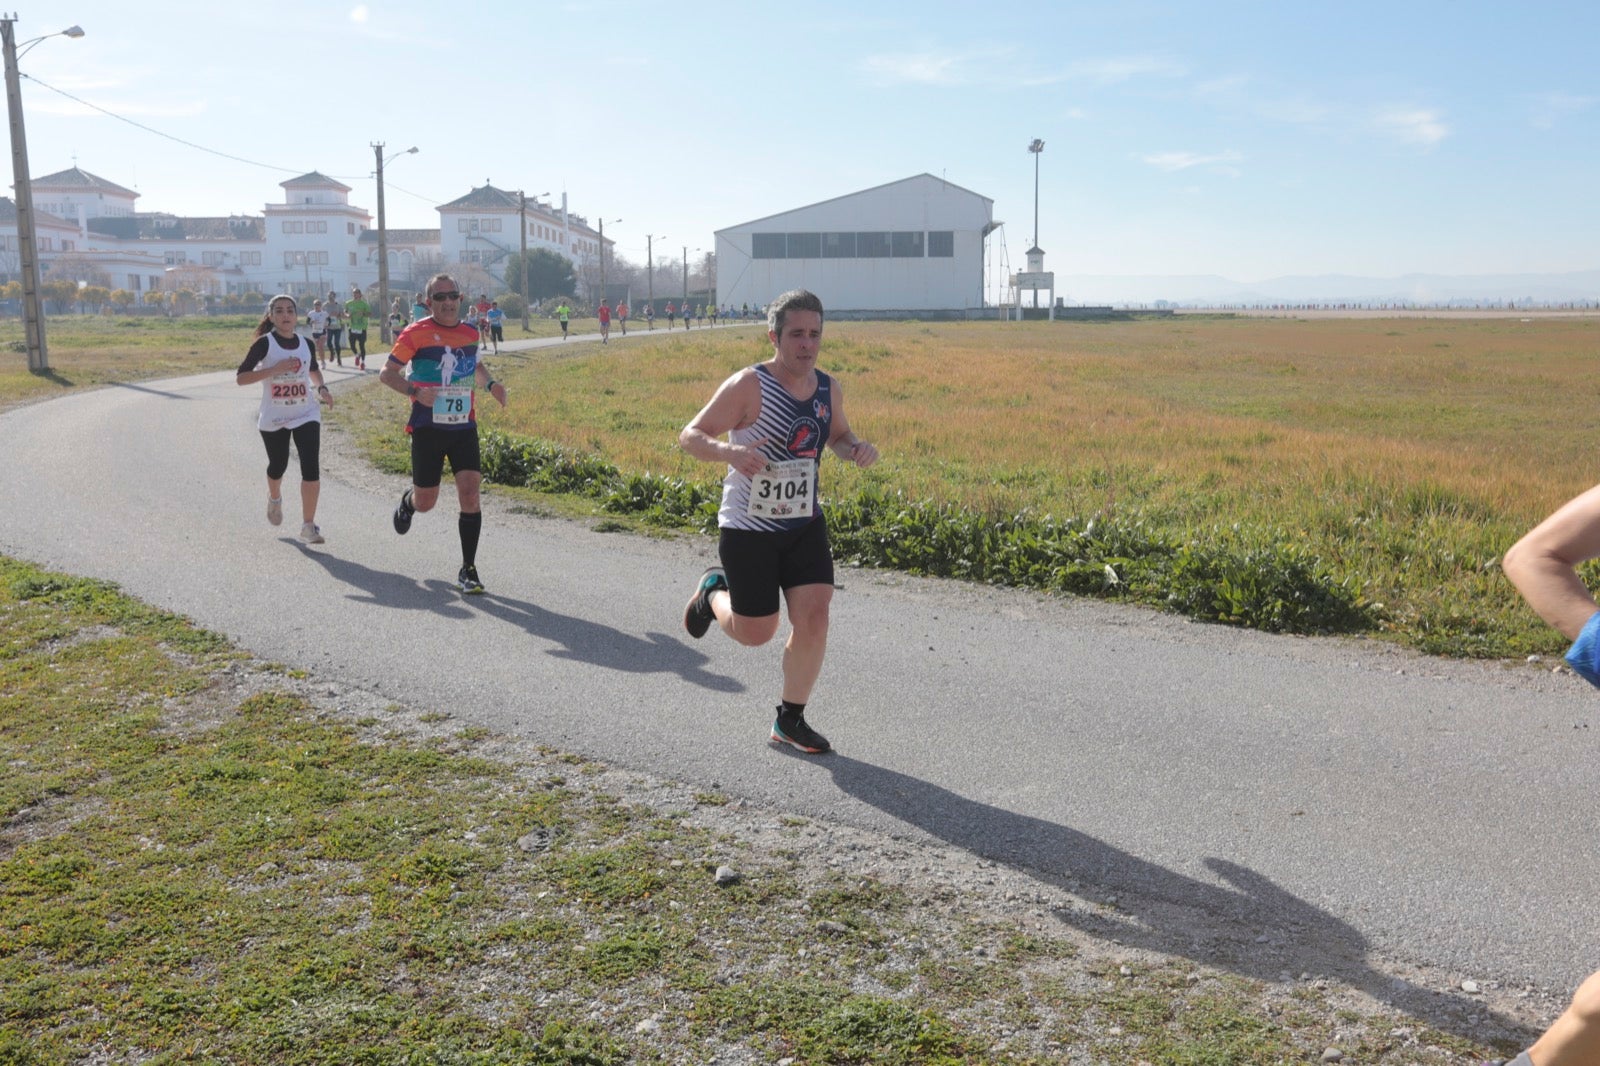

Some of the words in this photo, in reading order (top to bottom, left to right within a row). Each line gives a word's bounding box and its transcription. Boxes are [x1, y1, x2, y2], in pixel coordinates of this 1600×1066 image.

[273, 384, 306, 397] 2200
[446, 398, 463, 412] 78
[758, 479, 809, 500] 3104
